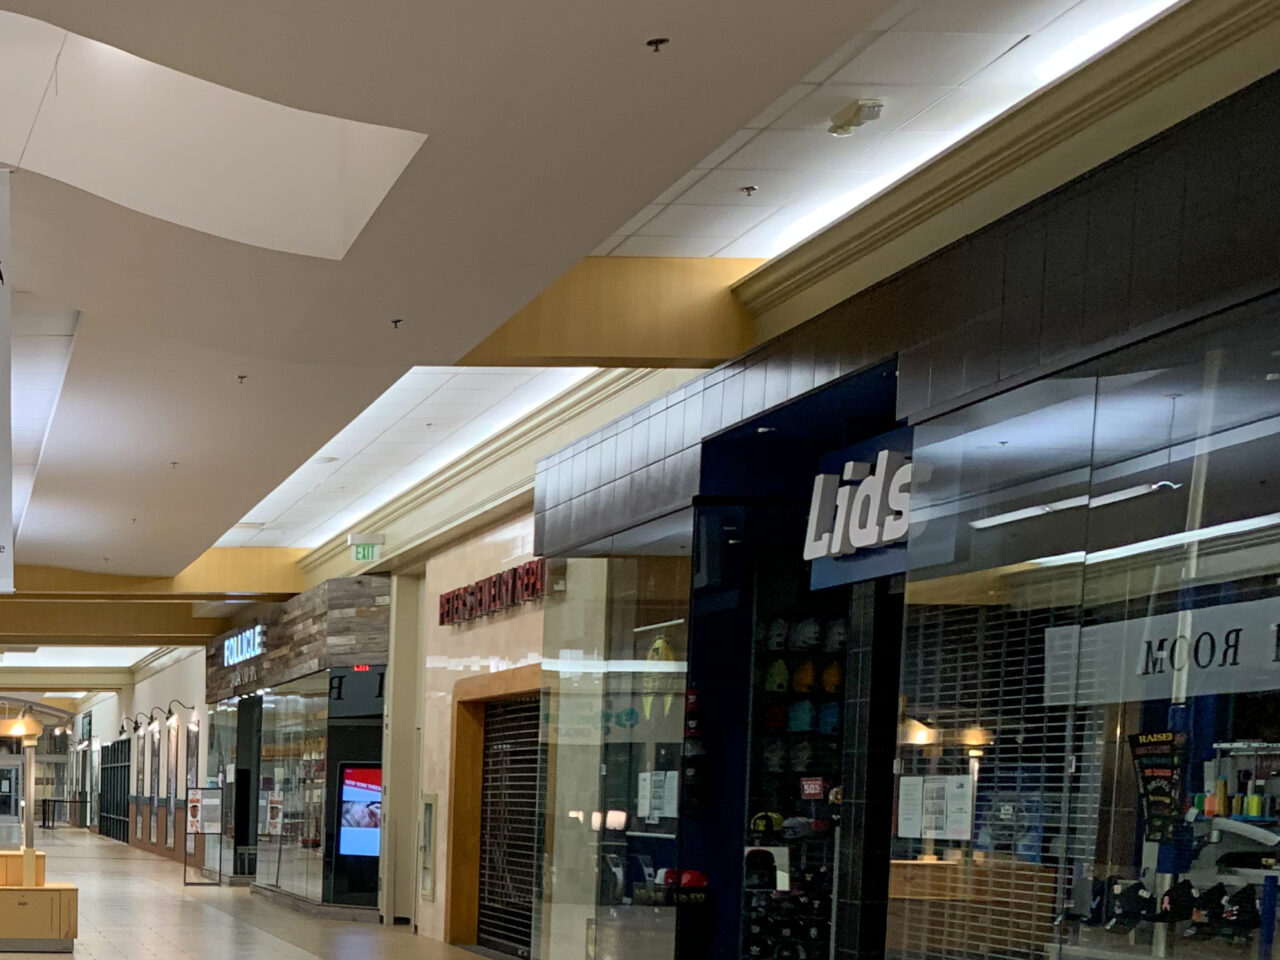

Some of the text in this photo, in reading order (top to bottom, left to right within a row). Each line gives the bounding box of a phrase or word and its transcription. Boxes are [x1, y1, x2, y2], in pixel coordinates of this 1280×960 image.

[803, 449, 913, 560] Lids
[356, 544, 375, 561] EXIT
[224, 625, 265, 667] FOLLICLE
